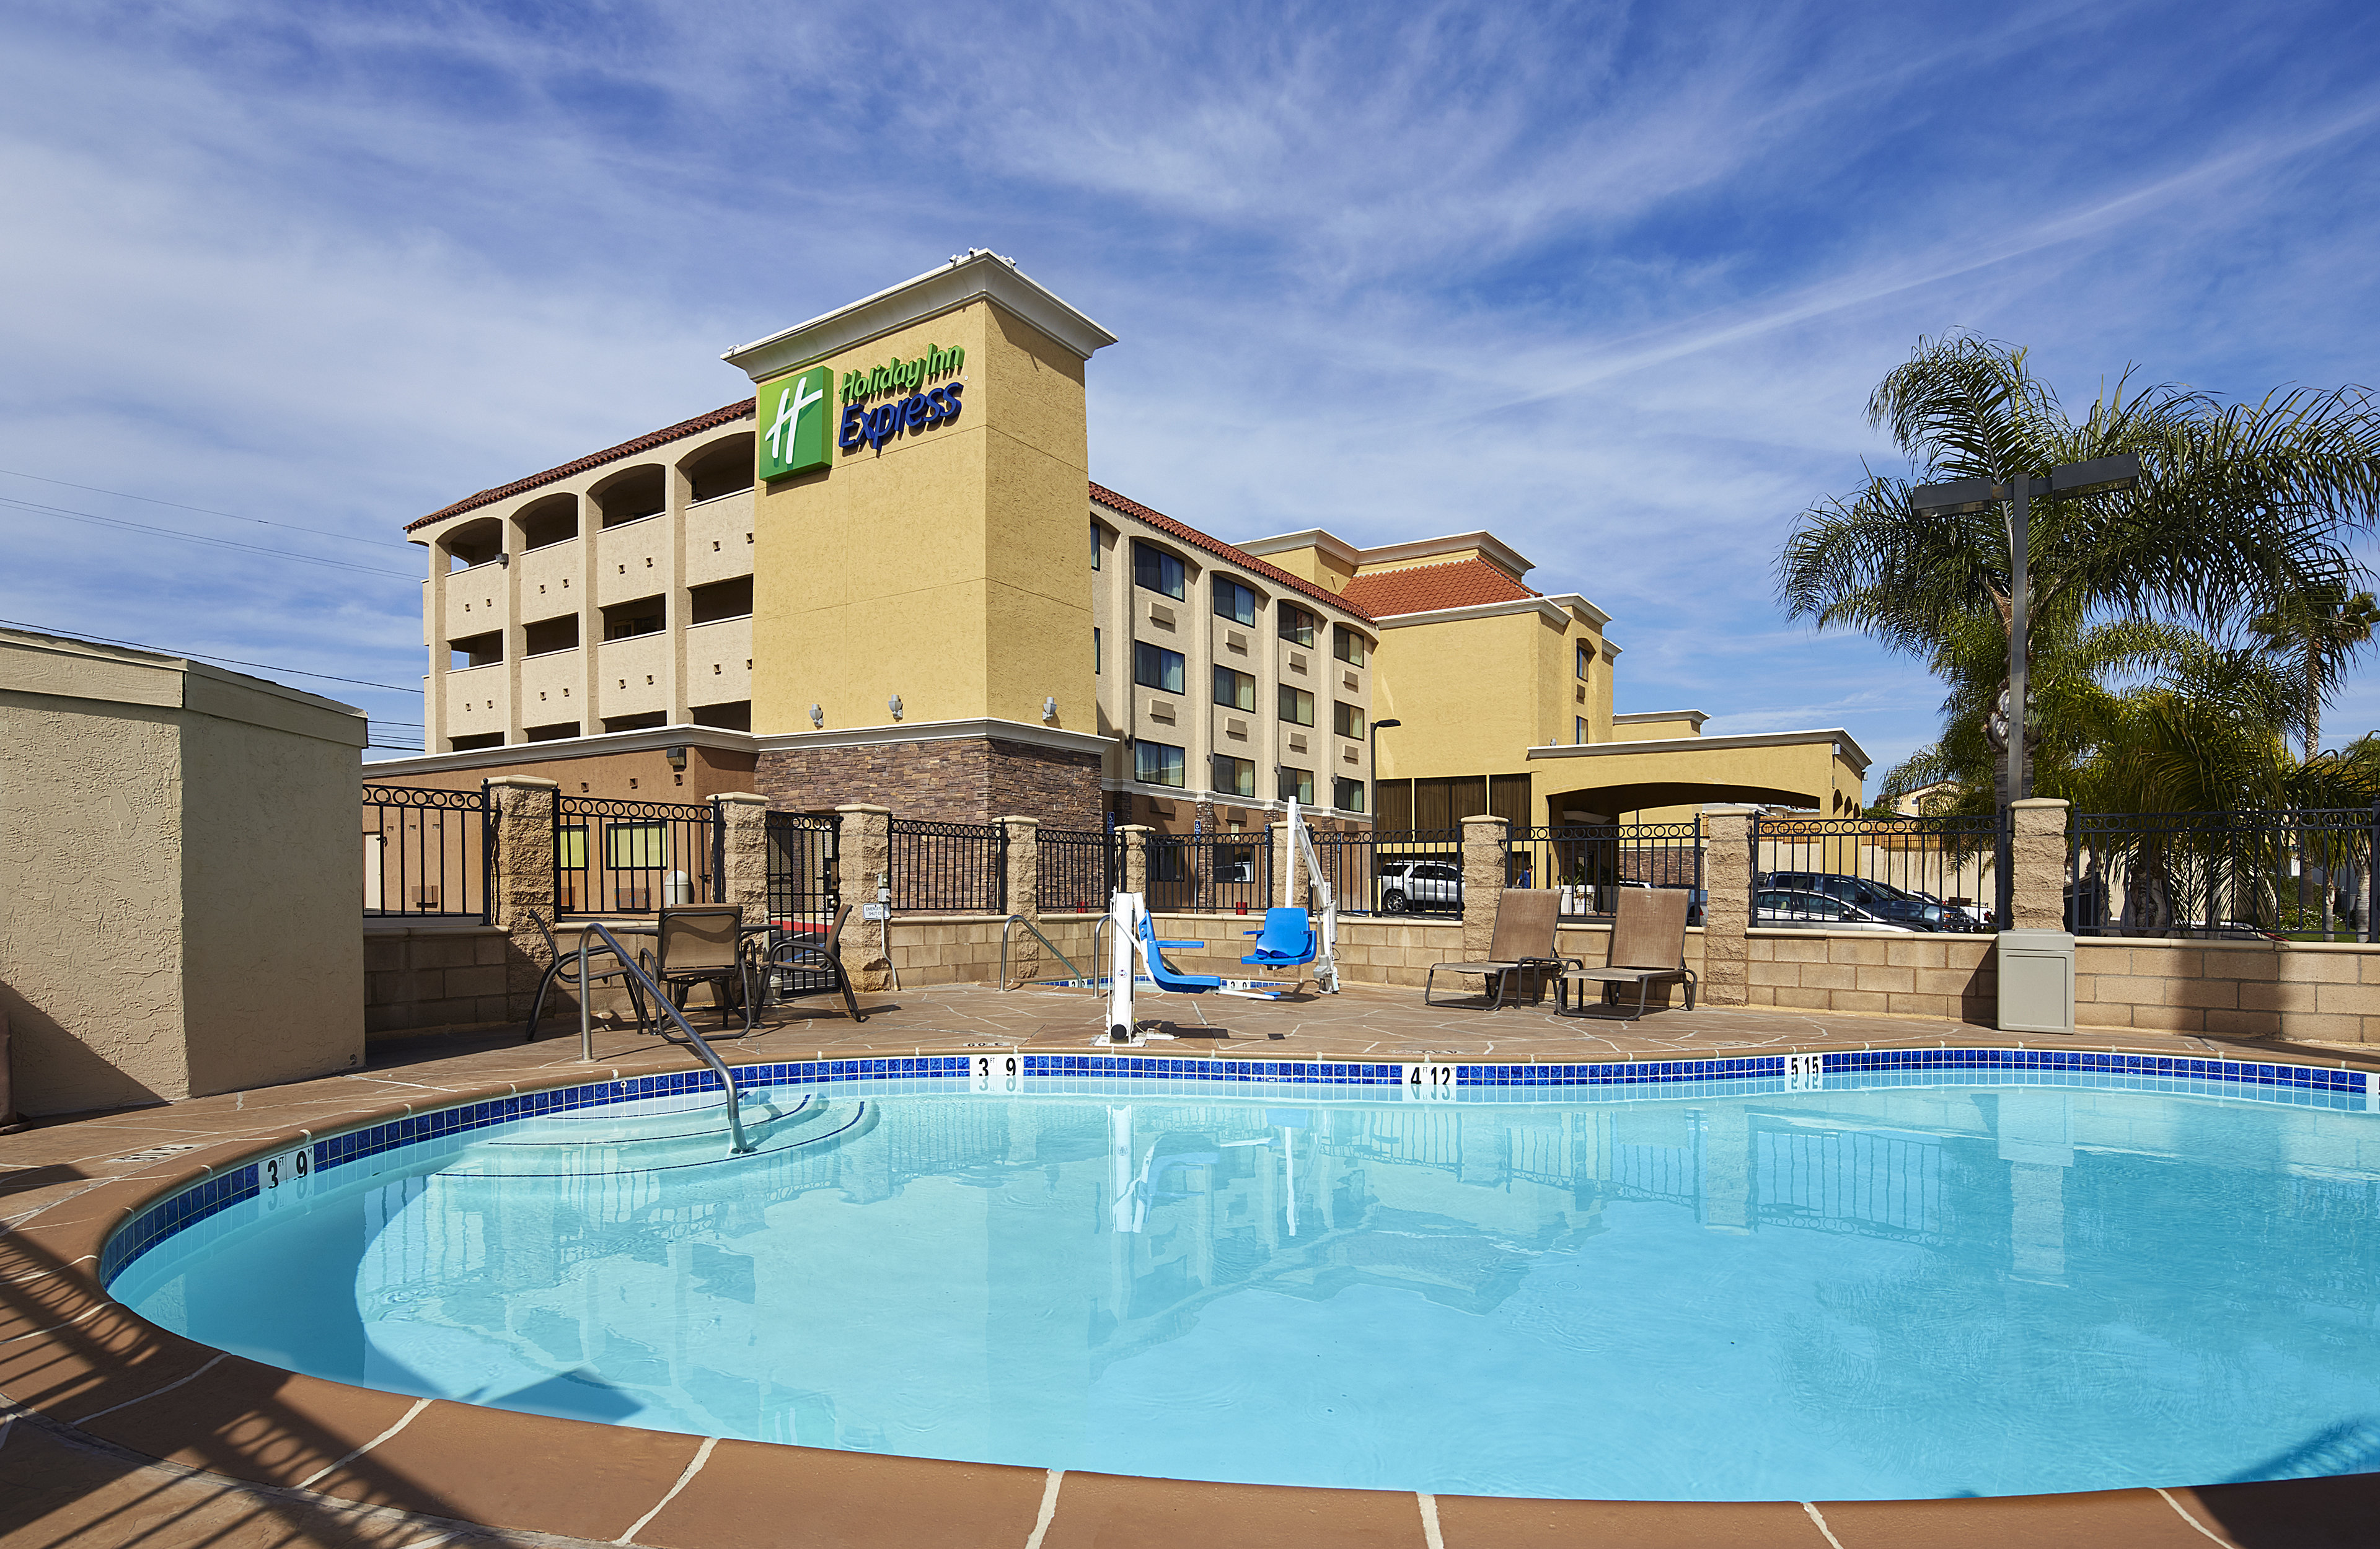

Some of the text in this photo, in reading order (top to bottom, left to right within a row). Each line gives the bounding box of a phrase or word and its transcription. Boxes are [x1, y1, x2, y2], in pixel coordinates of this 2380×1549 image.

[839, 343, 965, 403] Holiday Inn
[839, 382, 964, 451] Express
[979, 1058, 989, 1076] 3
[1411, 1067, 1422, 1084] 4
[1791, 1057, 1798, 1075] 5
[267, 1159, 278, 1189] 3
[279, 1156, 284, 1167] FT
[307, 1147, 312, 1156] M
